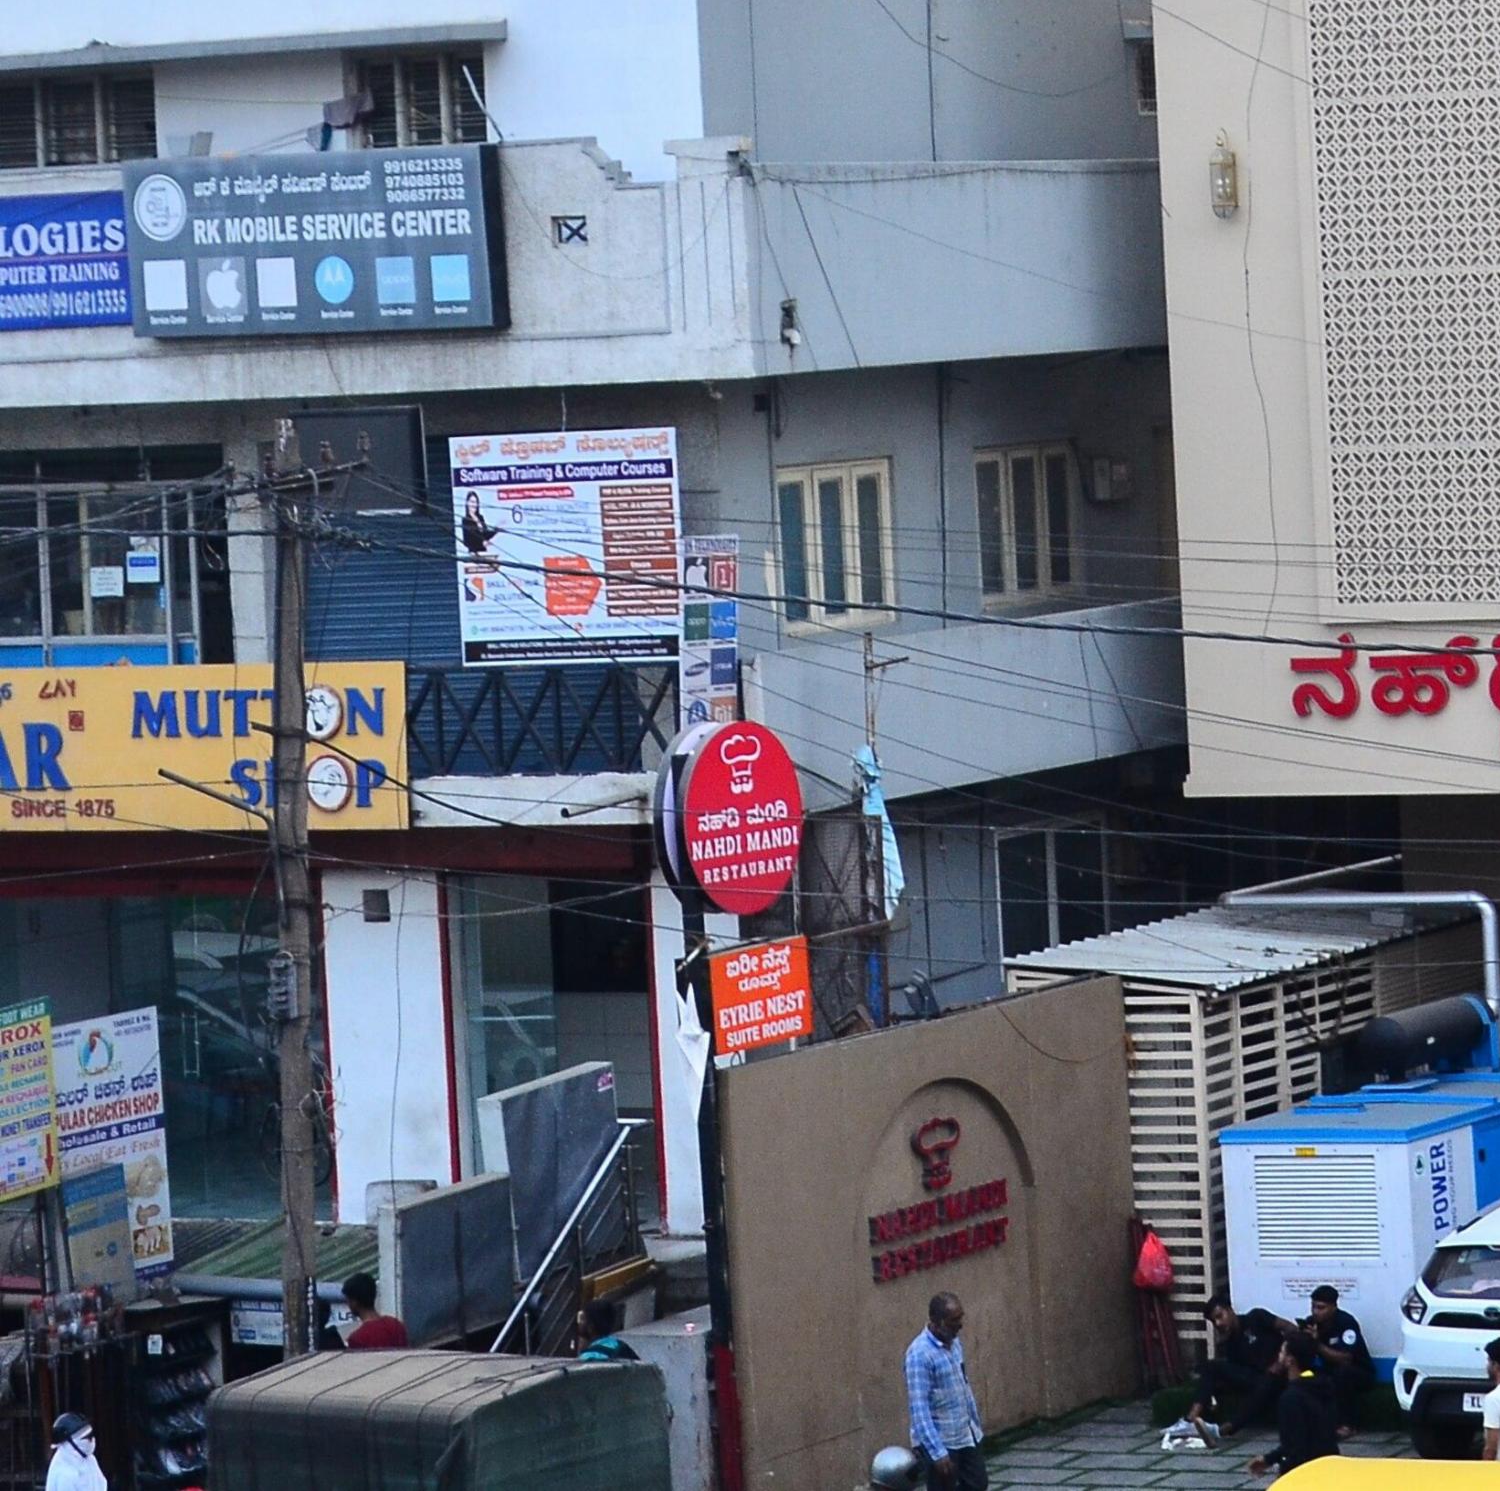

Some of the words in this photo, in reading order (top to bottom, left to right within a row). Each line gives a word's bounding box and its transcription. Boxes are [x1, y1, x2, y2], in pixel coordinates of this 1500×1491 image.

[193, 218, 227, 246] RK
[225, 213, 299, 244] MOBILE
[301, 210, 387, 241] SERVICE
[390, 208, 473, 237] CENTER
[50, 261, 120, 282] TRAINING
[460, 467, 508, 483] Software
[508, 464, 553, 482] Training
[555, 464, 564, 478] &
[565, 462, 619, 479] Computer
[620, 461, 667, 476] Courses
[11, 799, 67, 818] SINCE
[75, 798, 116, 818] 1875
[691, 833, 743, 862] NAHDI
[747, 825, 800, 852] MANDI
[703, 856, 793, 885] RESTAURANT
[720, 1001, 764, 1031] EYRIE
[766, 990, 806, 1016] NEST
[12, 1040, 46, 1058] XEROX
[726, 1027, 760, 1049] SUITE
[762, 1017, 803, 1039] ROOMS
[87, 1098, 133, 1126] CHICKEN
[133, 1092, 160, 1113] SHOP
[110, 1124, 120, 1137] &
[122, 1116, 156, 1135] Retail
[1430, 1141, 1450, 1231] POWER
[872, 1216, 1009, 1285] RESTAURANT
